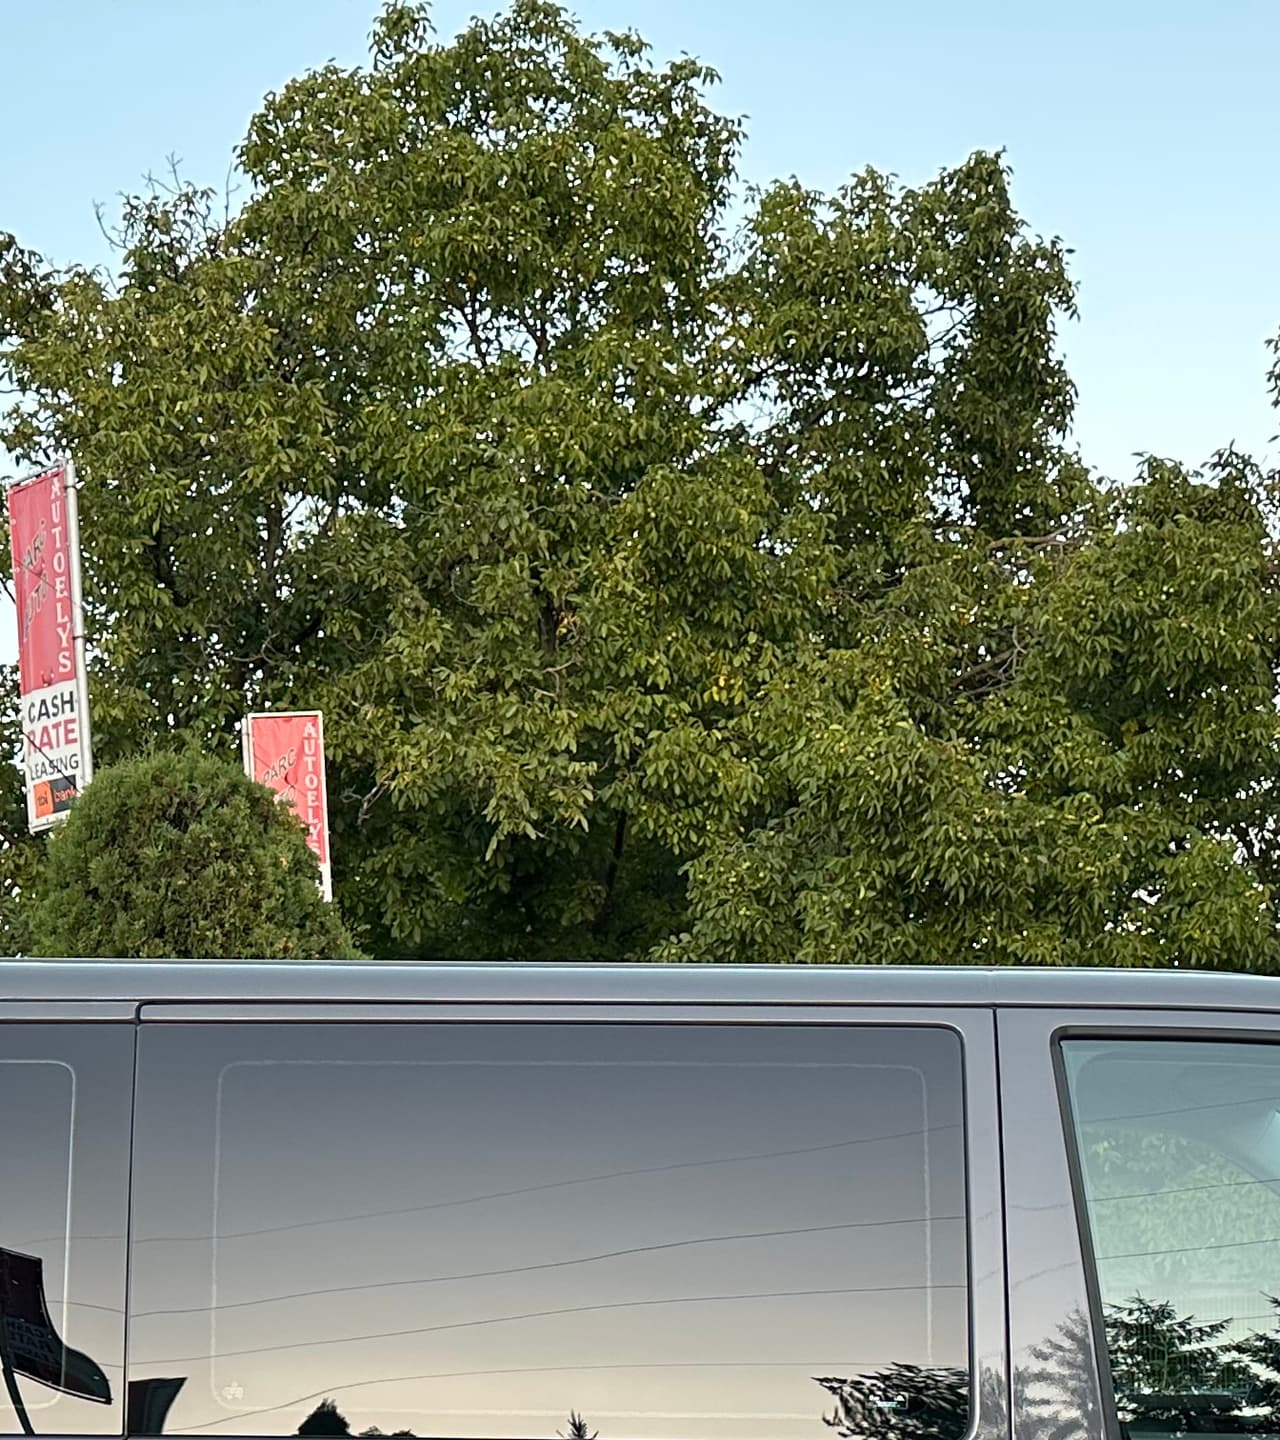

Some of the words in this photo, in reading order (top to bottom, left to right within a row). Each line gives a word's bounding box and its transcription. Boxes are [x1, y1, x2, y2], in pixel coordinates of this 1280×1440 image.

[50, 476, 72, 673] AUTOELYS
[28, 690, 75, 724] CASH
[27, 718, 79, 757] RATE
[31, 753, 80, 781] LEASING
[263, 748, 297, 785] PARC
